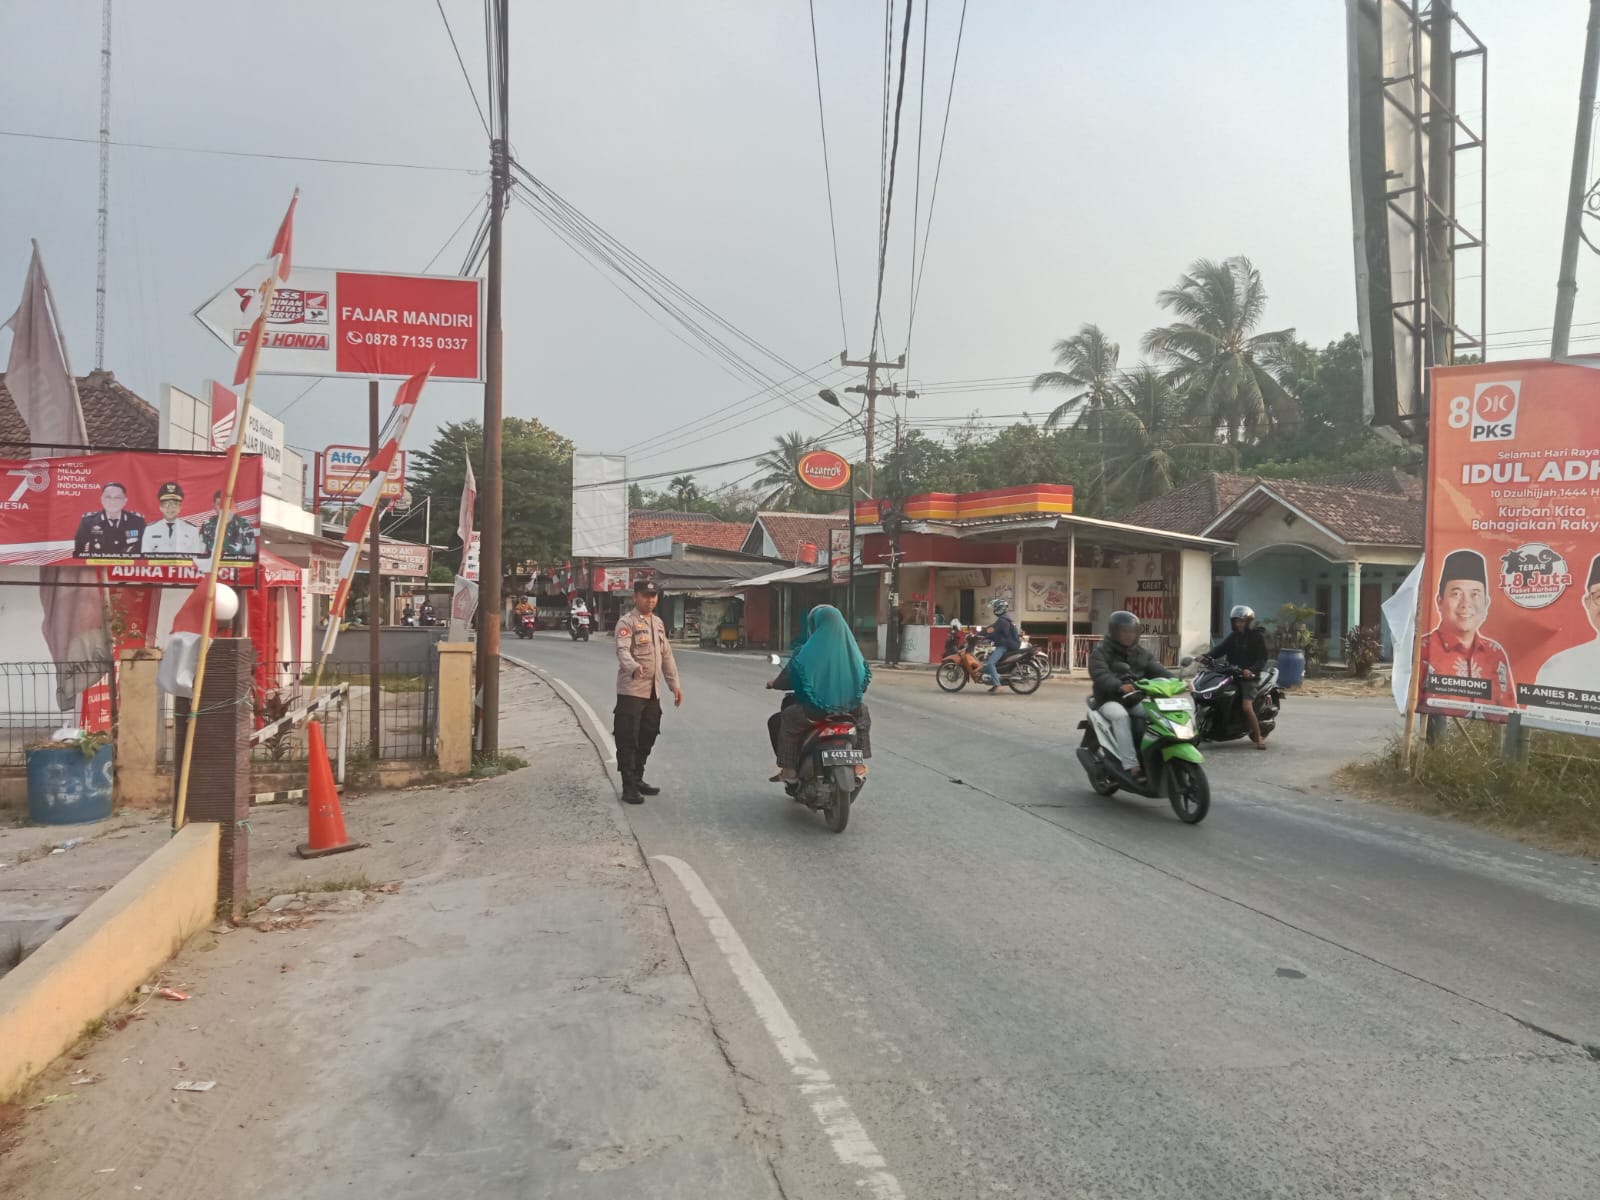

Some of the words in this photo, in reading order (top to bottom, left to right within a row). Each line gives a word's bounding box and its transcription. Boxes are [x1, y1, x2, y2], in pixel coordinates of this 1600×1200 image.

[342, 307, 398, 323] FAJAR
[403, 311, 473, 328] MANDIRI
[236, 331, 269, 346] PS
[272, 334, 326, 349] HONDA
[365, 333, 397, 346] 0878
[402, 335, 433, 348] 7135
[437, 338, 468, 350] 0337
[1448, 396, 1471, 428] 8
[1473, 424, 1512, 439] PKS
[243, 433, 259, 451] AJAR
[1498, 451, 1541, 459] Selamat
[1544, 449, 1568, 457] Hari
[1571, 448, 1600, 457] Raya
[1462, 462, 1530, 484] IDUL
[1503, 488, 1557, 498] Dzulhijjah
[1560, 488, 1587, 496] 1444
[1499, 506, 1550, 517] Kurban
[1554, 506, 1585, 517] Kita
[1472, 520, 1556, 532] Bahagiakan
[1500, 573, 1523, 588] 1.8
[1527, 571, 1572, 586] Juta
[1431, 676, 1439, 684] H.
[1441, 677, 1488, 689] GEMBONG
[1520, 686, 1530, 695] H.
[1532, 688, 1565, 699] ANIES
[1567, 692, 1578, 700] R.
